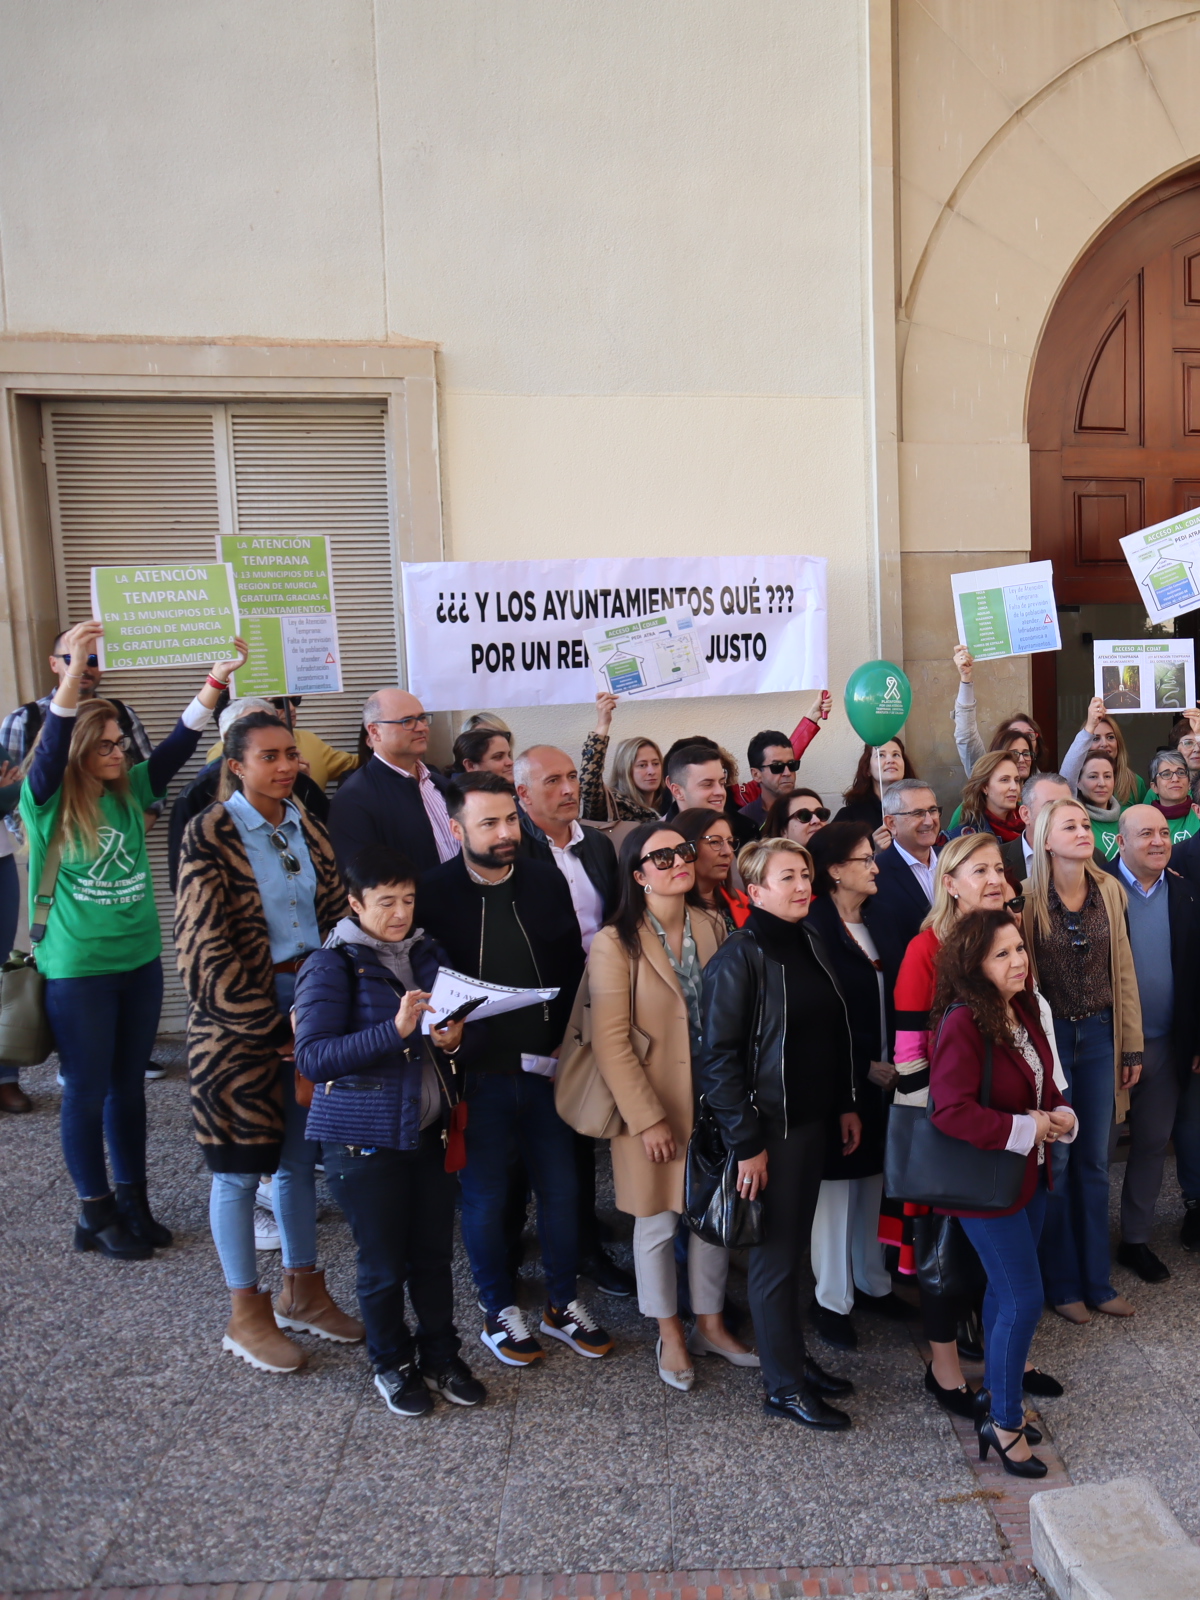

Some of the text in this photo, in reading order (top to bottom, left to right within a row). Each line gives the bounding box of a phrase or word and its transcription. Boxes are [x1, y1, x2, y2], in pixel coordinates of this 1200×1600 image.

[252, 537, 310, 548] ATENCIÓN
[1148, 528, 1172, 542] ACCESO
[242, 556, 309, 566] TEMPRANA
[115, 566, 208, 584] LA ATENCIÓN
[238, 581, 270, 590] REGIÓN
[123, 589, 208, 604] TEMPRANA
[436, 578, 794, 624] ¿¿¿ Y LOS AYUNTAMIENTOS QUÉ ???
[105, 606, 231, 622] EN 13 MUNICIPIOS DE LA
[251, 606, 326, 614] AYUNTAMIENTOS
[121, 621, 221, 636] REGIÓN DE MURCIA
[608, 628, 629, 636] ACCESO
[107, 643, 119, 652] ES
[123, 639, 179, 650] GRATUITA
[182, 636, 225, 647] GRACIAS
[113, 650, 232, 667] LOS AYUNTAMIENTOS
[472, 641, 516, 673] POR
[522, 641, 550, 670] UN
[558, 638, 591, 670] RE
[706, 633, 766, 664] JUSTO
